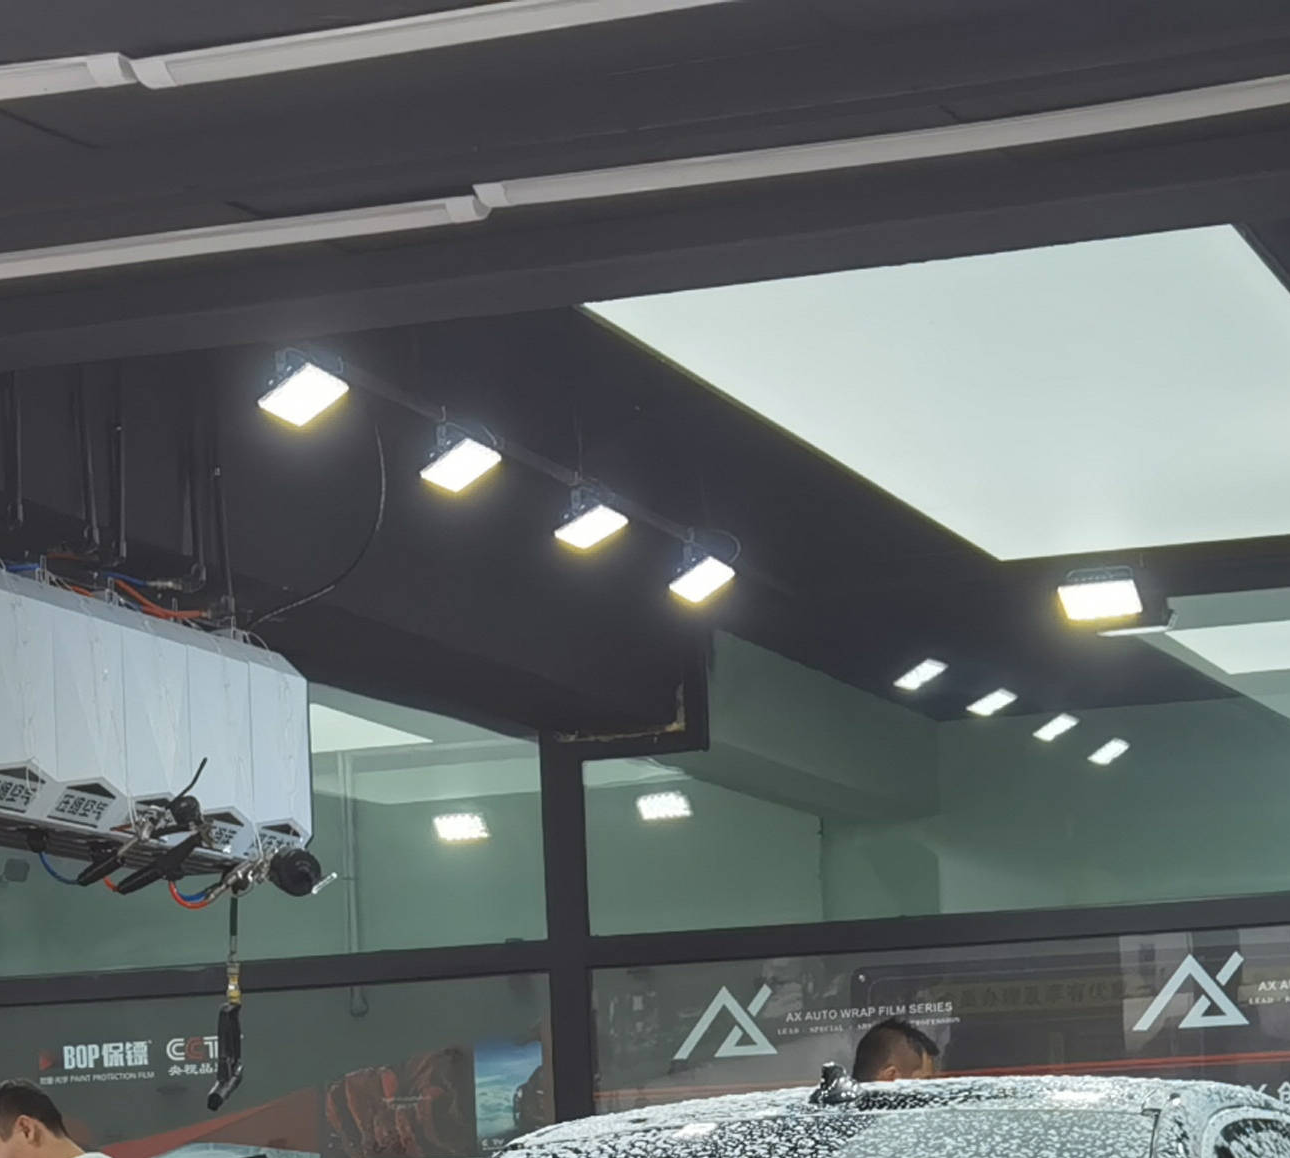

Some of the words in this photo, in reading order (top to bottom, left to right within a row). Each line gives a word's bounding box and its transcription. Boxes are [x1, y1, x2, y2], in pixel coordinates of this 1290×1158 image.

[1258, 980, 1276, 991] AX
[786, 1012, 802, 1023] AX
[805, 1009, 838, 1021] AUTO
[840, 1006, 876, 1019] WRAP
[878, 1004, 906, 1016] FILM
[909, 1002, 953, 1014] SERIES
[166, 1035, 220, 1061] CCT
[168, 1062, 219, 1077] 央视品
